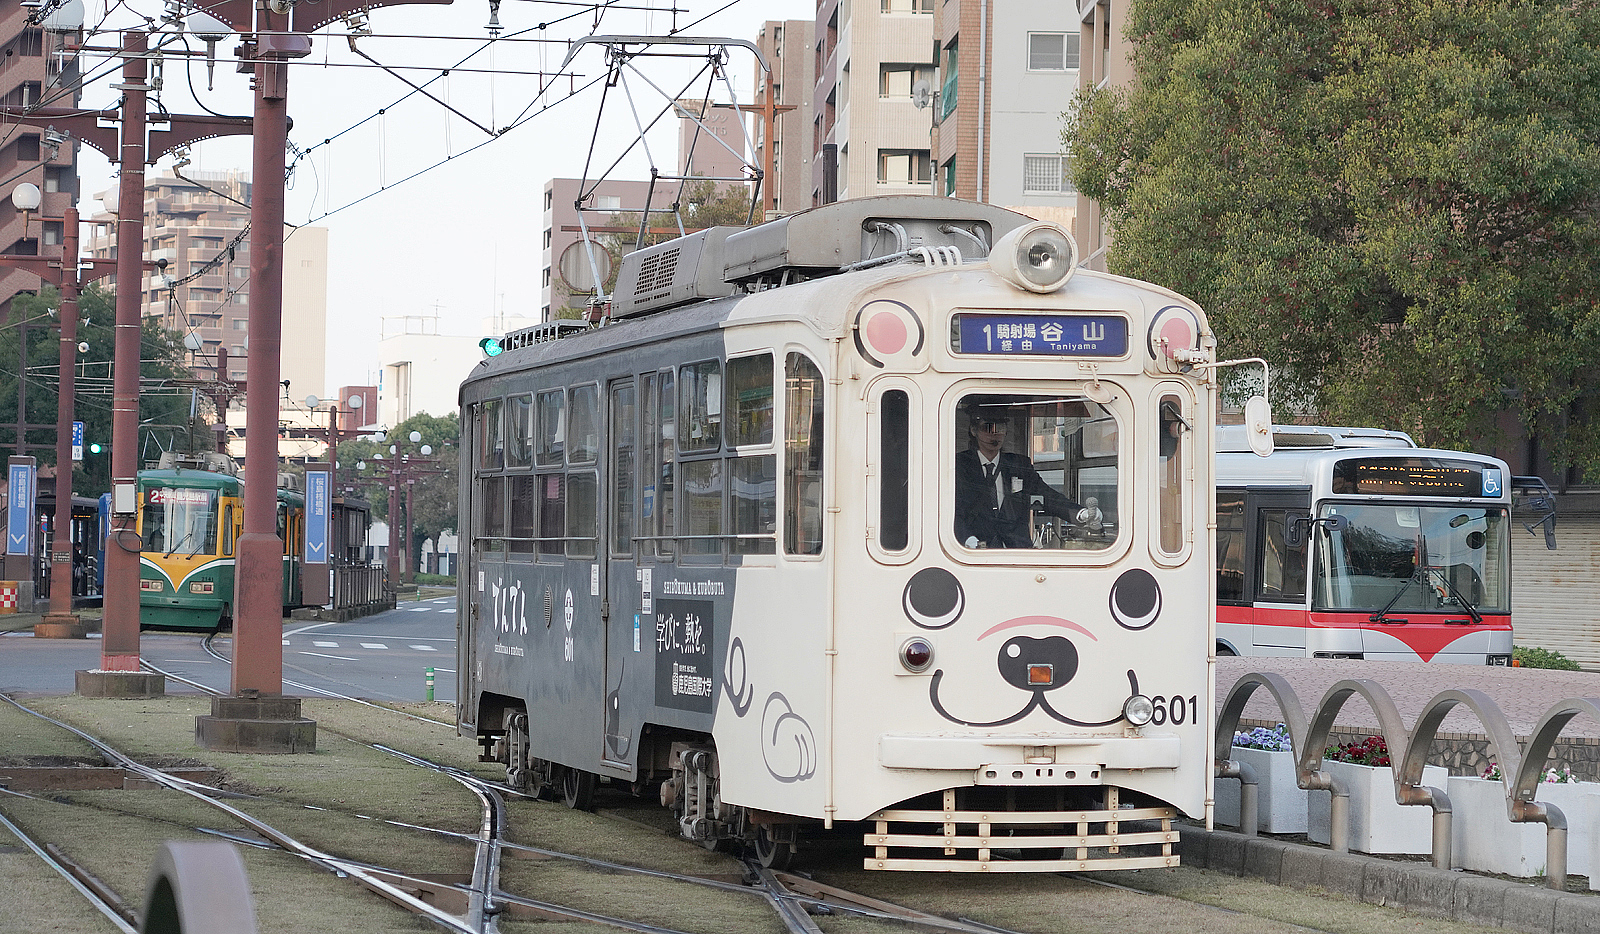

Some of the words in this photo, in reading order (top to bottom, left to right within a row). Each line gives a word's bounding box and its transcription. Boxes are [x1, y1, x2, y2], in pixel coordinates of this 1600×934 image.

[982, 324, 992, 352] 1
[996, 323, 1037, 339] 騎射場
[1040, 321, 1105, 342] 谷山
[1001, 340, 1033, 352] 経由
[1050, 343, 1097, 352] Taniyama
[150, 489, 160, 503] 2
[692, 582, 697, 595] &
[492, 577, 528, 636] でんでん
[678, 674, 712, 698] 鹿児島国際大学
[1151, 694, 1198, 726] 601
